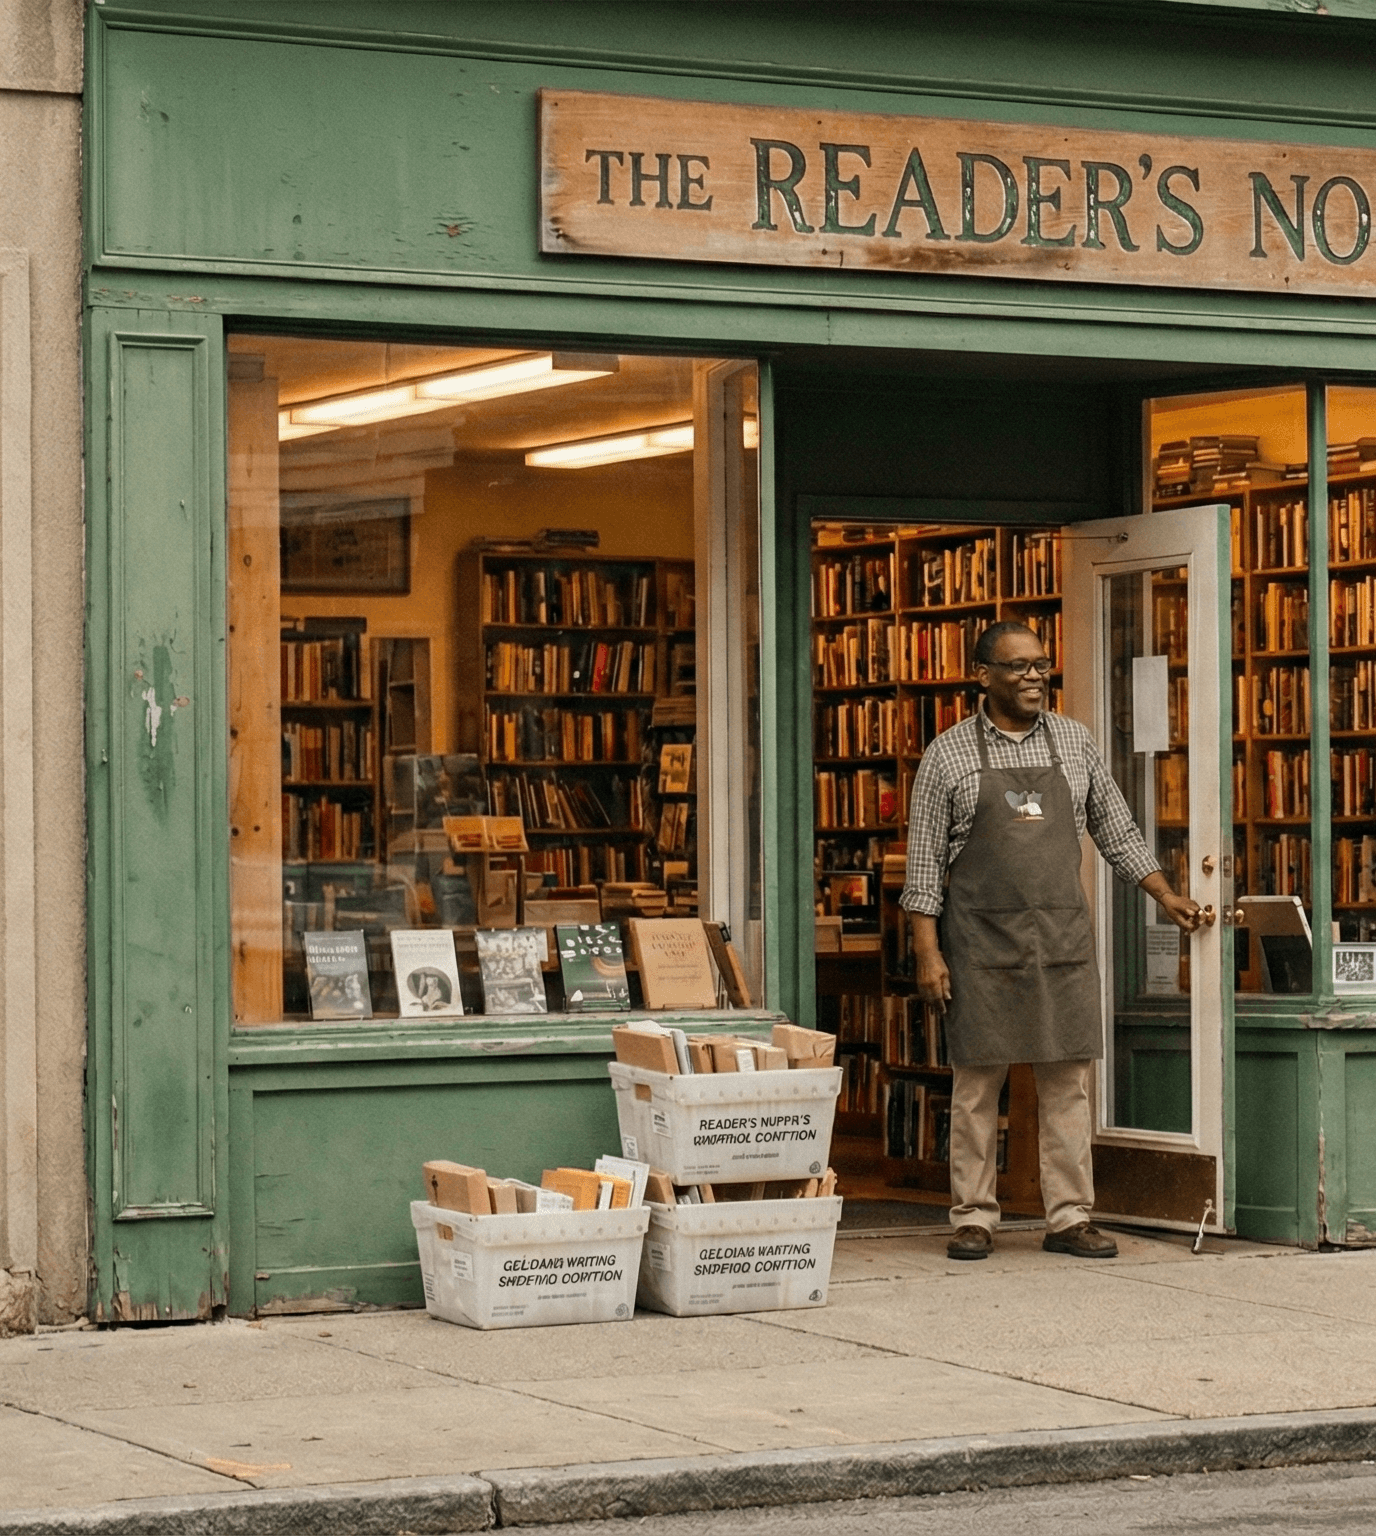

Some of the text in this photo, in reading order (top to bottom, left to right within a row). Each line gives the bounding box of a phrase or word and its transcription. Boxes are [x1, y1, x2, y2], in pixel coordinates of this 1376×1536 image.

[585, 149, 714, 211] THE
[750, 138, 1204, 256] READER'S
[699, 1117, 757, 1131] READER'S
[566, 1254, 617, 1268] WRITING
